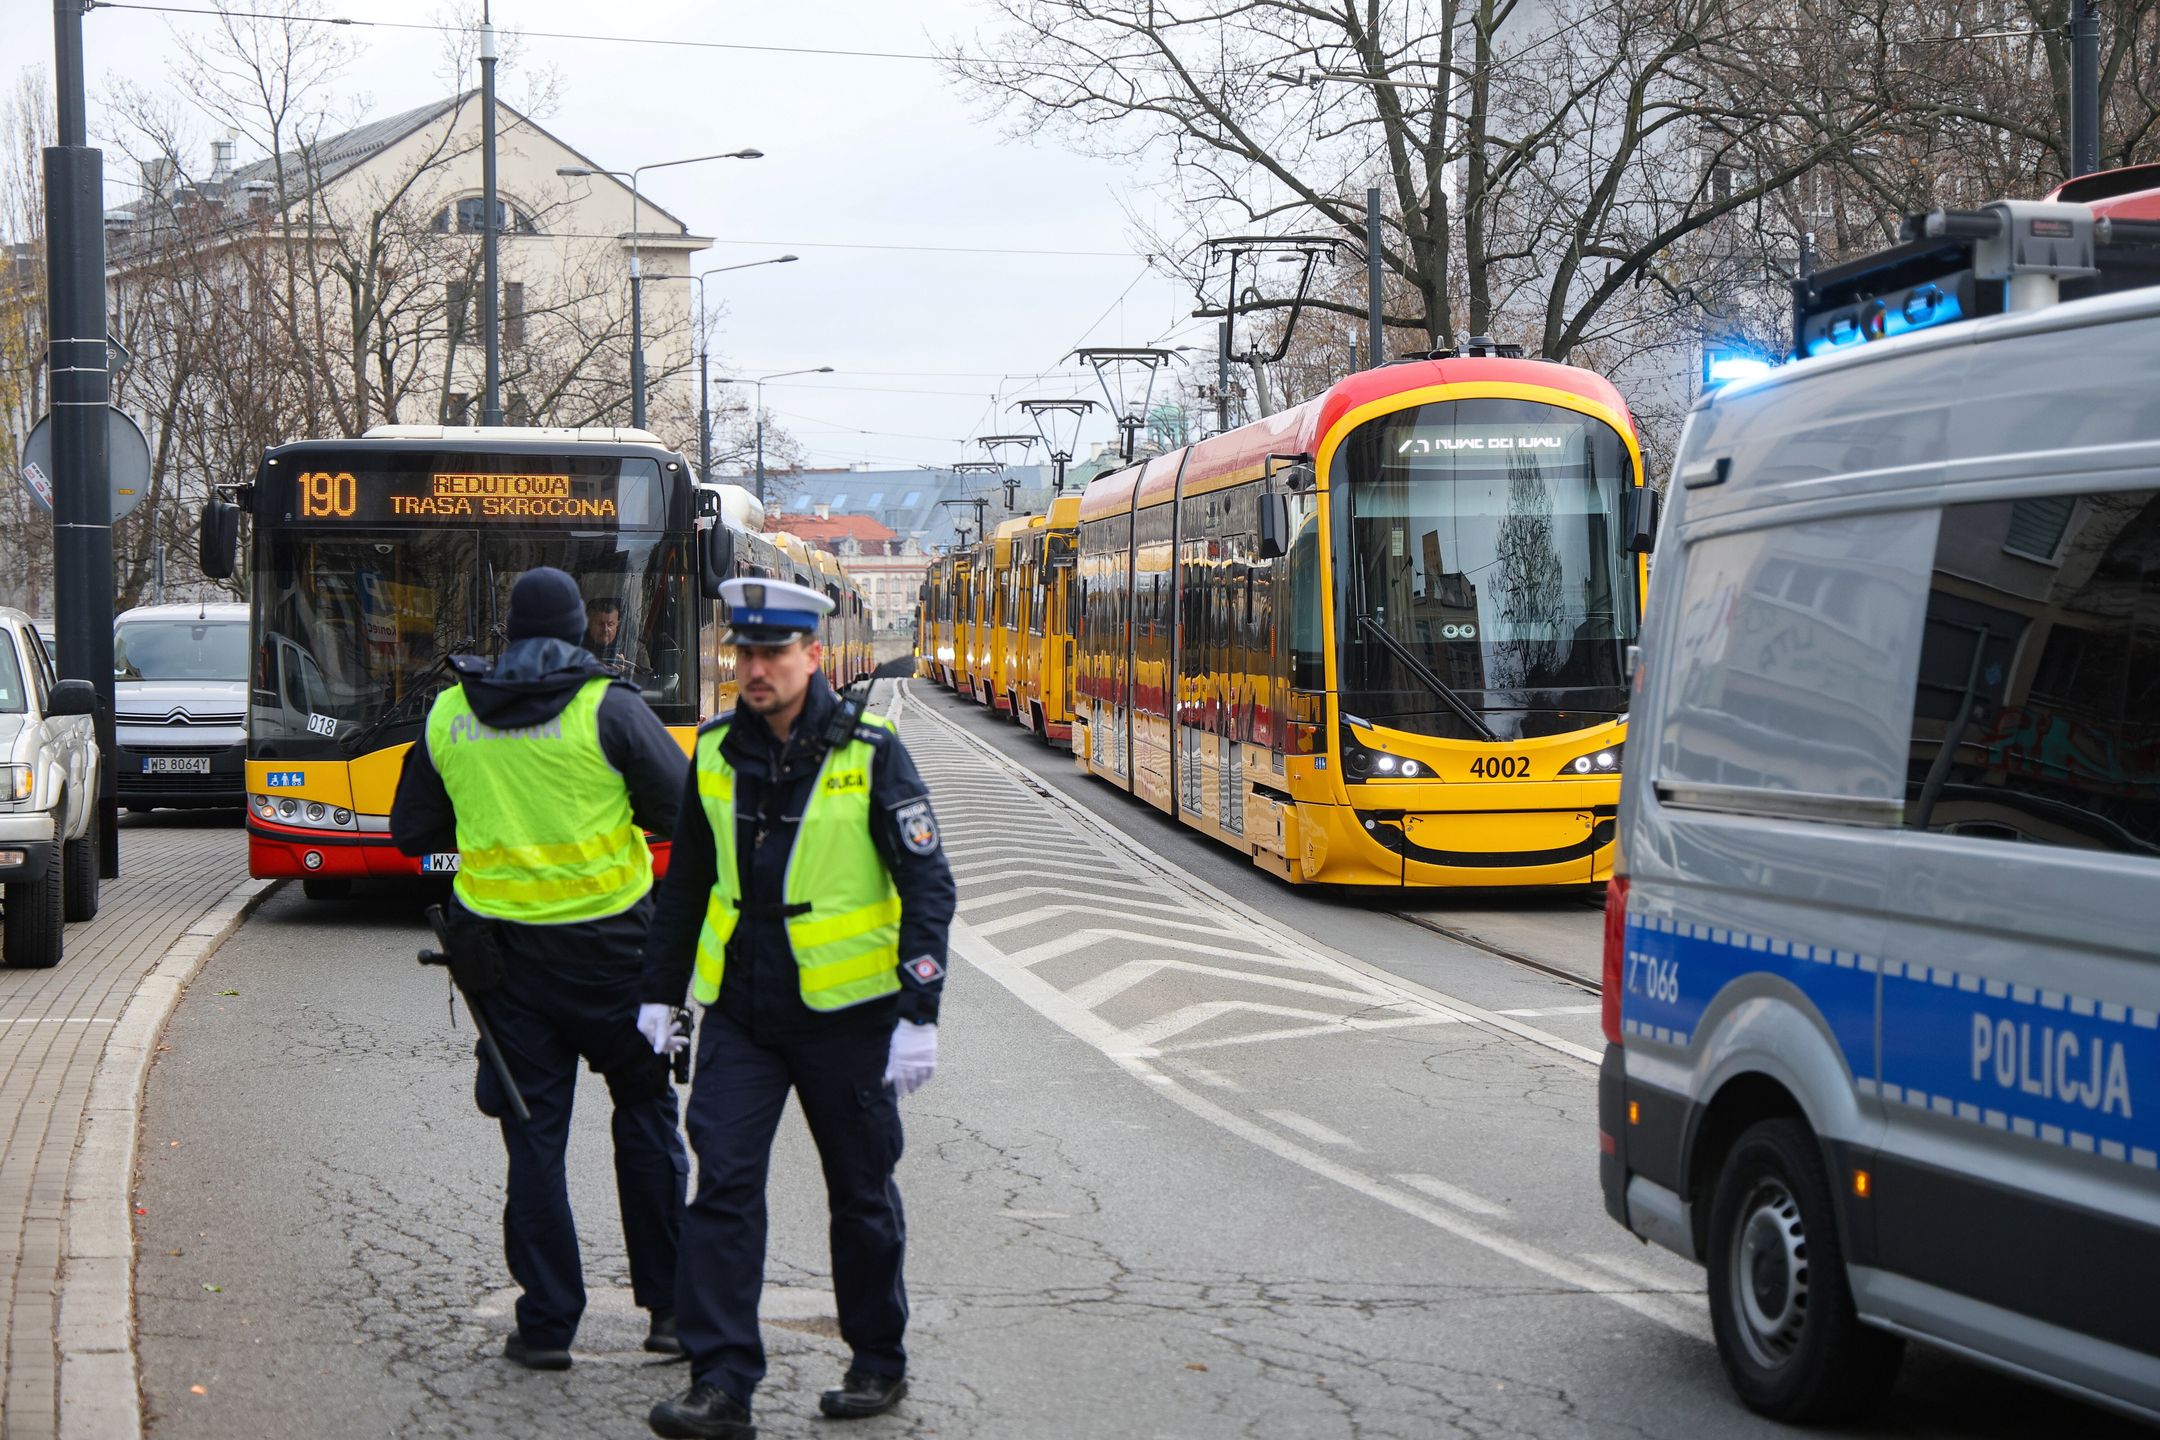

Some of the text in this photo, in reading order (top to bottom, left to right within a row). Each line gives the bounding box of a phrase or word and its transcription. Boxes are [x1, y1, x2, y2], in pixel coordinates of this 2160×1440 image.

[298, 472, 357, 517] 190
[435, 476, 567, 495] REDUTOWA
[390, 496, 472, 515] TRASA
[309, 714, 335, 736] 018
[151, 758, 167, 770] WB
[170, 758, 208, 770] 8064Y
[1470, 756, 1531, 778] 4002
[432, 854, 456, 870] WX
[1972, 1011, 2133, 1120] POLICJA
